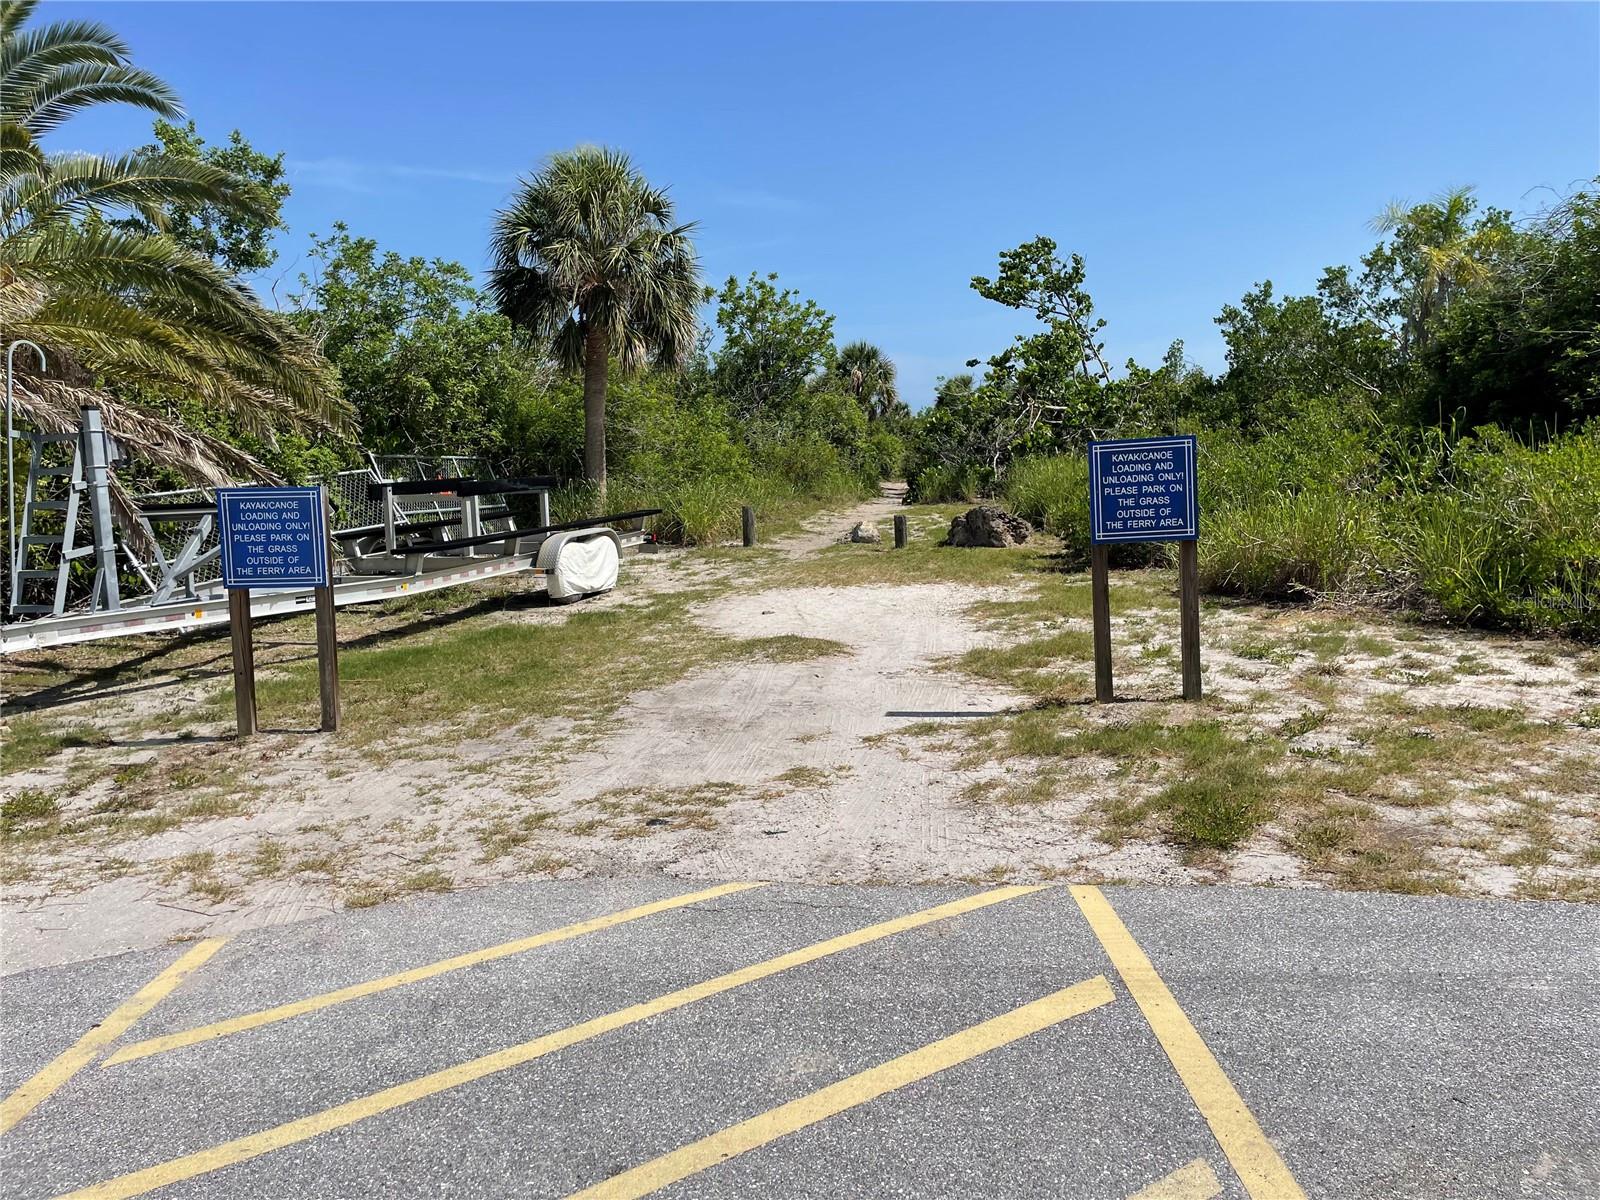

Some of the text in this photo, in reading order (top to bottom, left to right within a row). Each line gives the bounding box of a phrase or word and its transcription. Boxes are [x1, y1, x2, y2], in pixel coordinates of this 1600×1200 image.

[1112, 451, 1173, 462] KAYAK/CANOE
[1112, 464, 1151, 473] LOADING
[1103, 472, 1183, 484] UNLOADING ONLY!
[1105, 486, 1138, 495] PLEASE
[1140, 496, 1169, 505] GRASS
[240, 501, 299, 510] KAYAK/CANOE
[1117, 509, 1155, 518] OUTSIDE
[1128, 520, 1156, 528] FERRY
[1160, 519, 1183, 527] AREA
